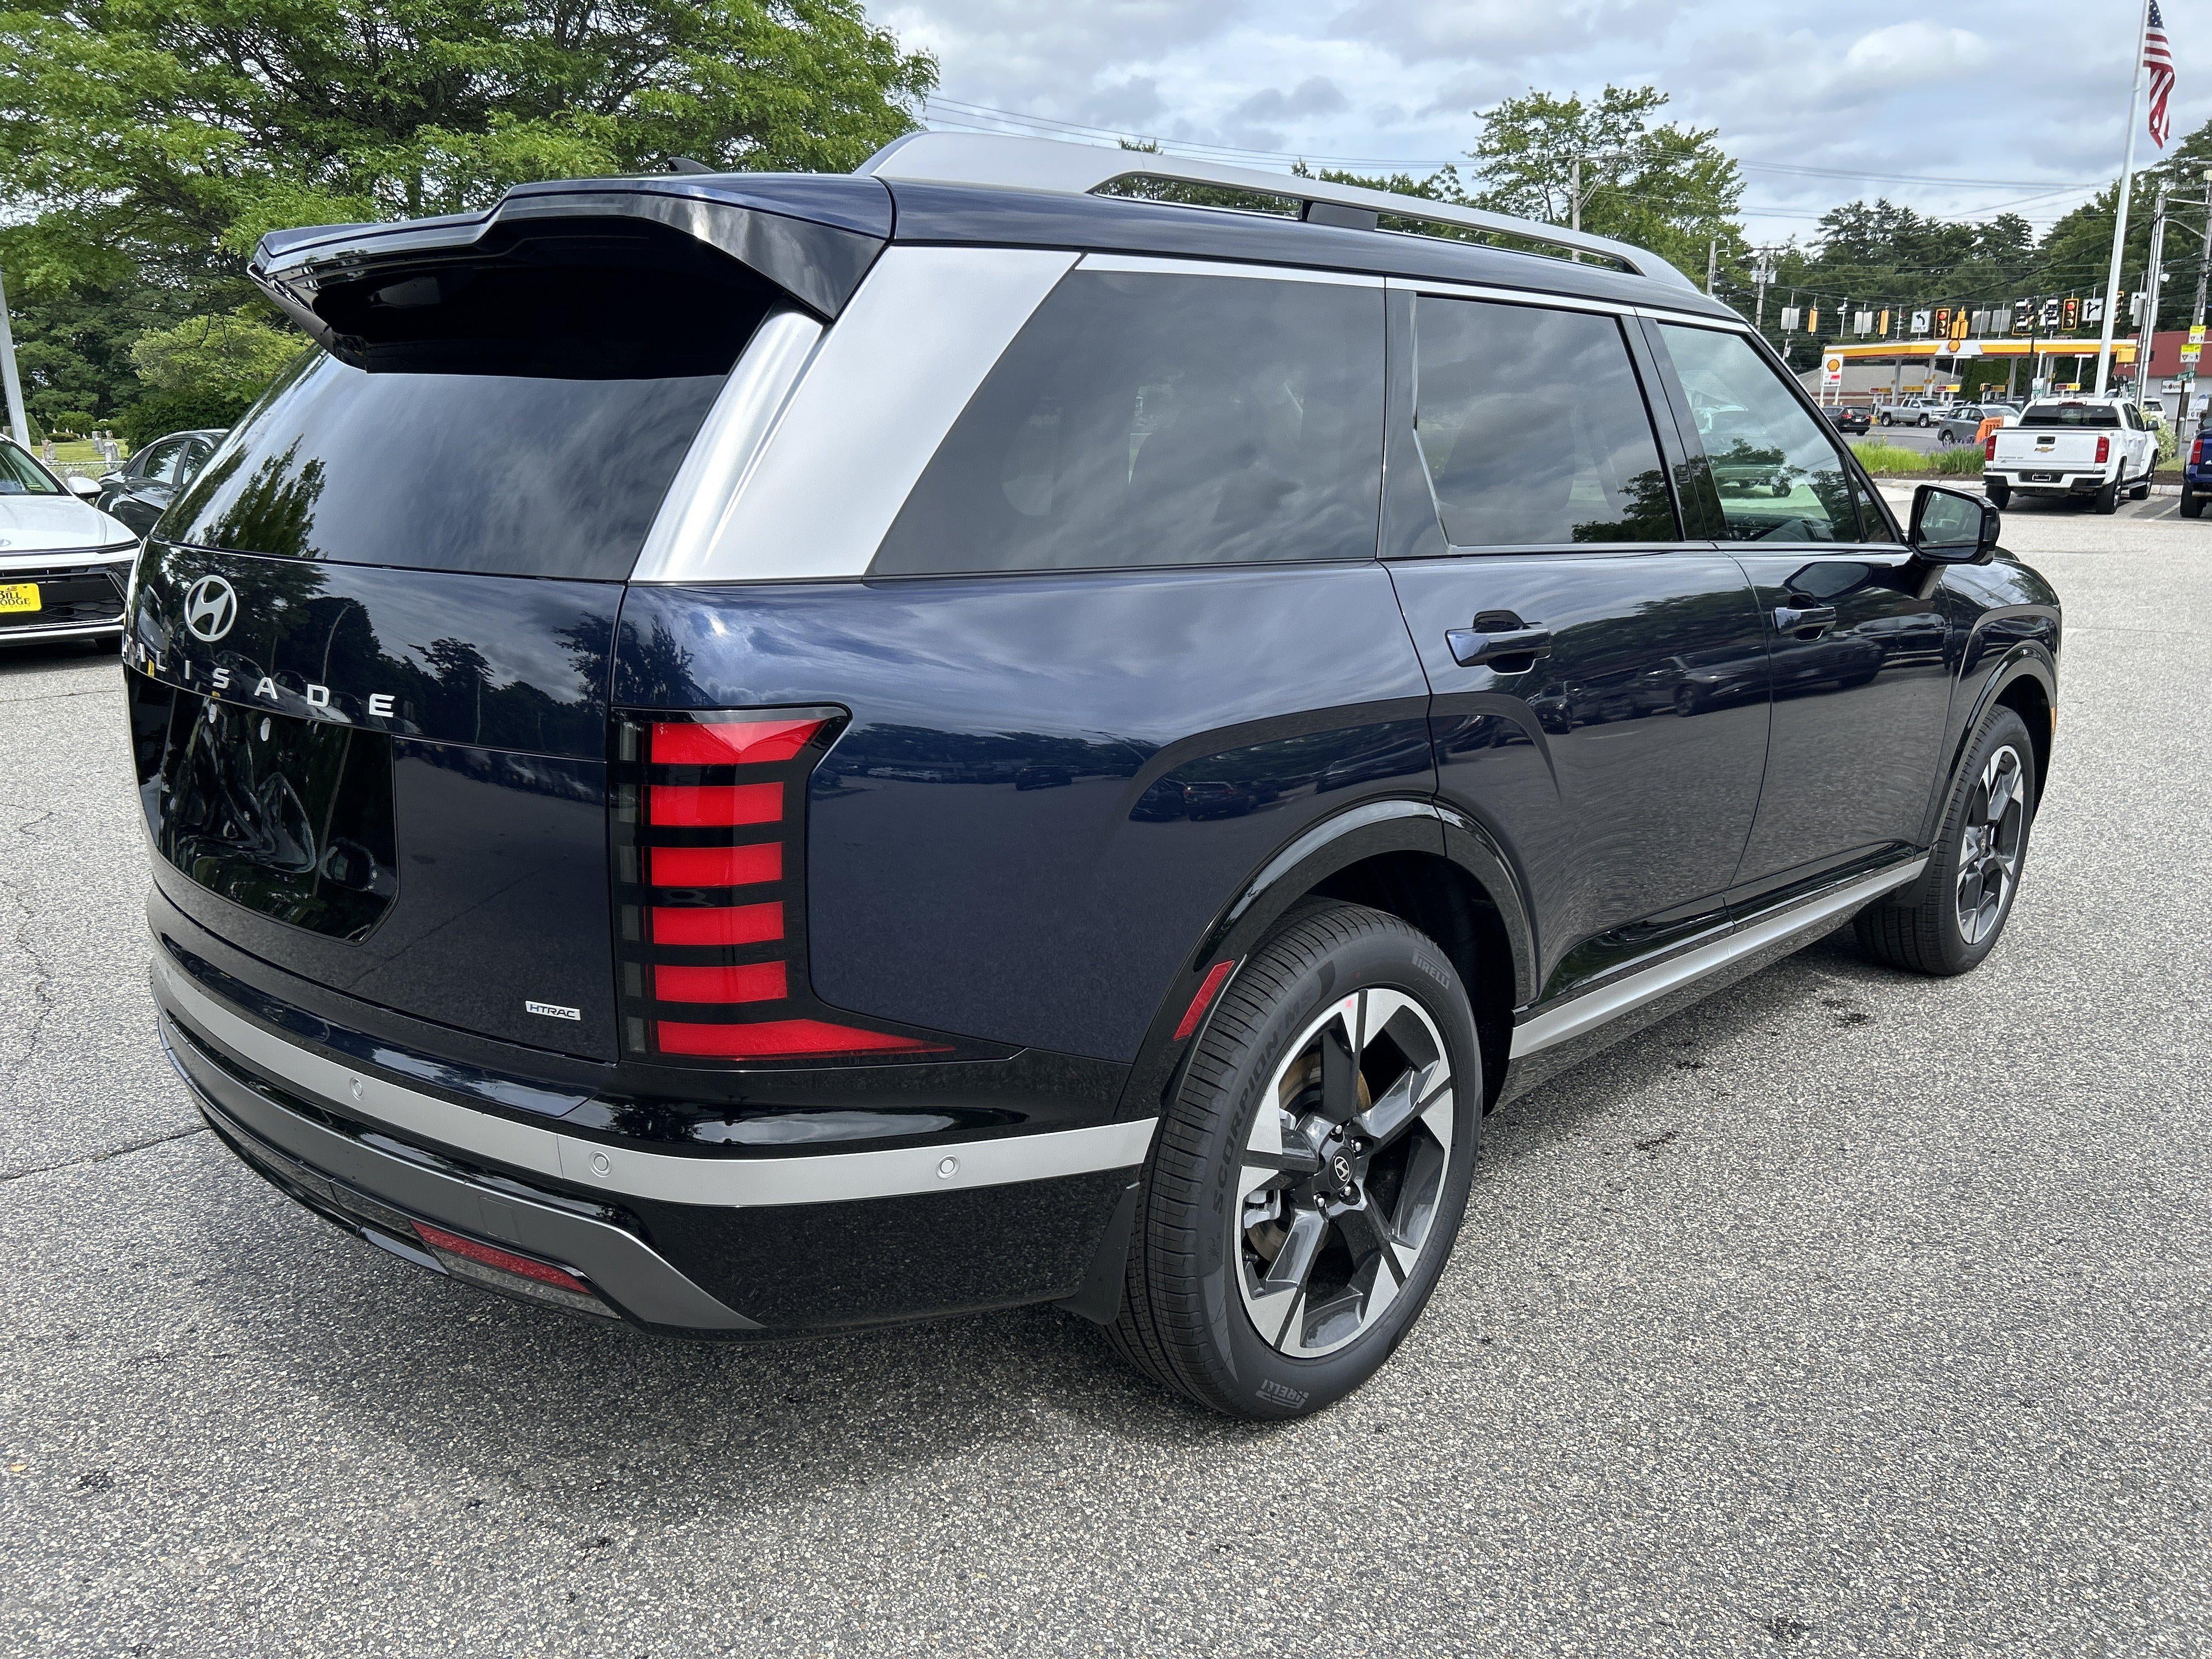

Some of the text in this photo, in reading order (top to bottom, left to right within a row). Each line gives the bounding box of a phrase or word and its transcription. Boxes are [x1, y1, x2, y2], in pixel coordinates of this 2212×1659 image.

[0, 591, 22, 600] BILL
[0, 597, 31, 606] ODGE
[1412, 947, 1451, 990] PIRELLI
[529, 1004, 575, 1018] HTRAC
[1212, 1032, 1279, 1214] SCORPION
[1255, 1378, 1310, 1409] PIRELLI
